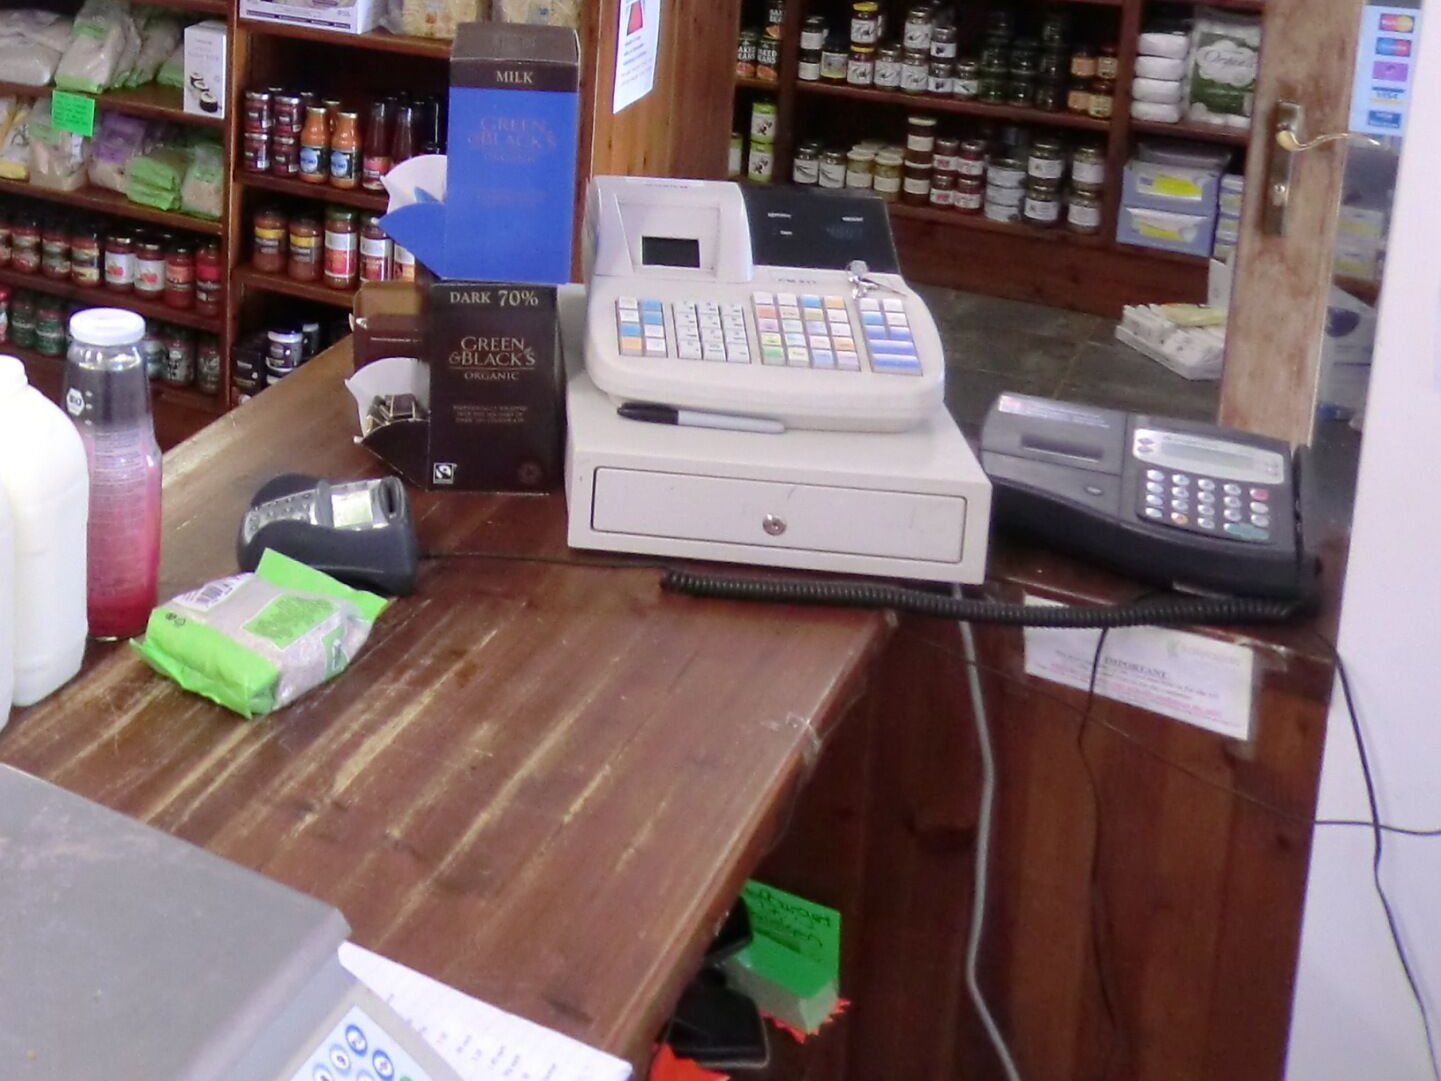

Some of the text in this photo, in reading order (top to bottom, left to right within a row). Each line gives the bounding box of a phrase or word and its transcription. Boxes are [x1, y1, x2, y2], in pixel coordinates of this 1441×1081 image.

[495, 70, 534, 84] MILK
[449, 289, 539, 307] DARK 70%
[460, 335, 526, 352] GREEN
[463, 370, 521, 381] ORGANIC
